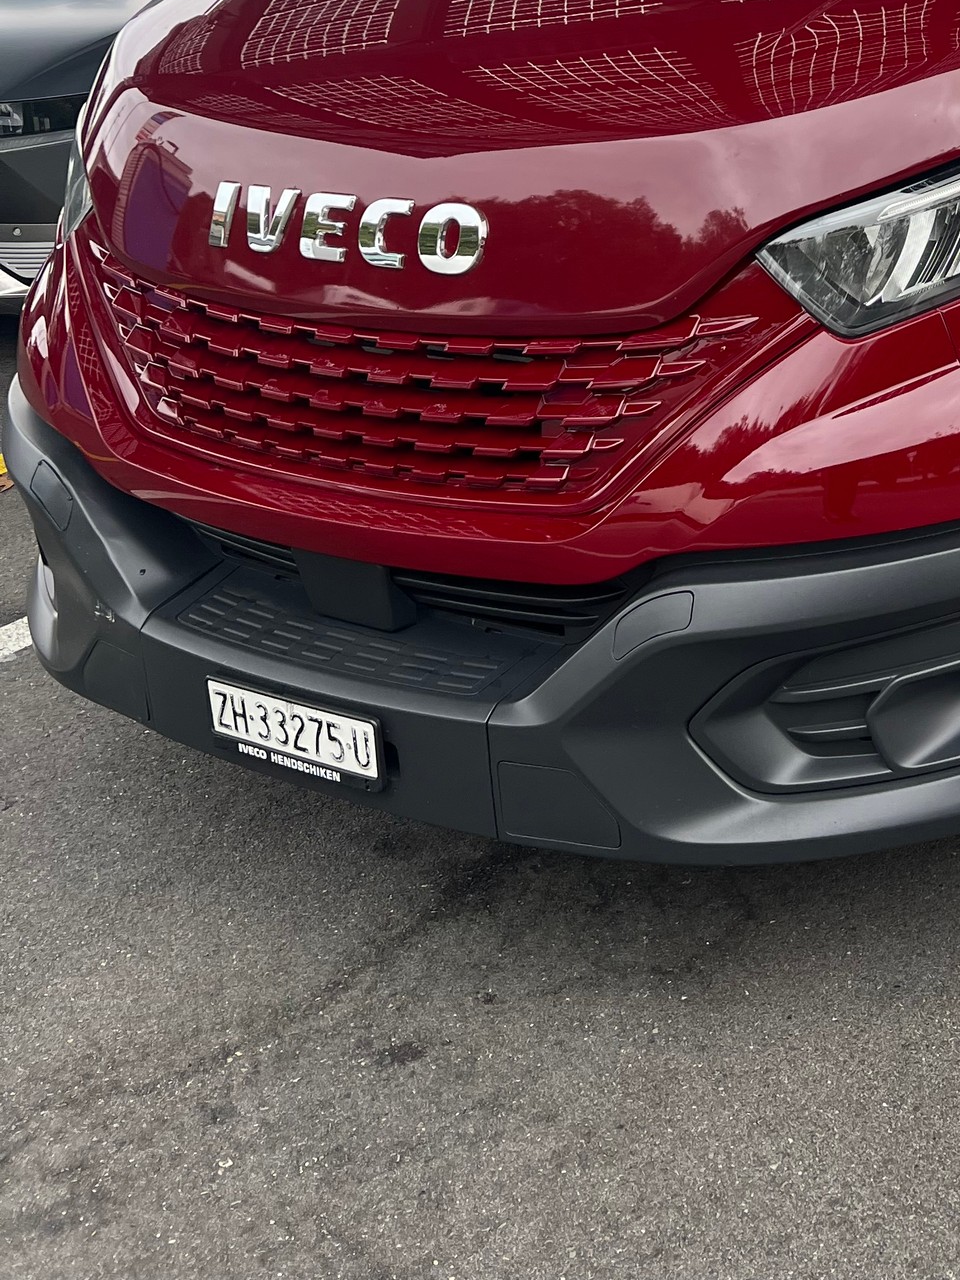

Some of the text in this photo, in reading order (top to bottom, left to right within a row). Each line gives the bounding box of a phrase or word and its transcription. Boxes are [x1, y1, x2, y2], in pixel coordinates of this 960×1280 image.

[208, 180, 490, 275] IVECO
[238, 742, 341, 783] IVECO HENDSCHIKEN
